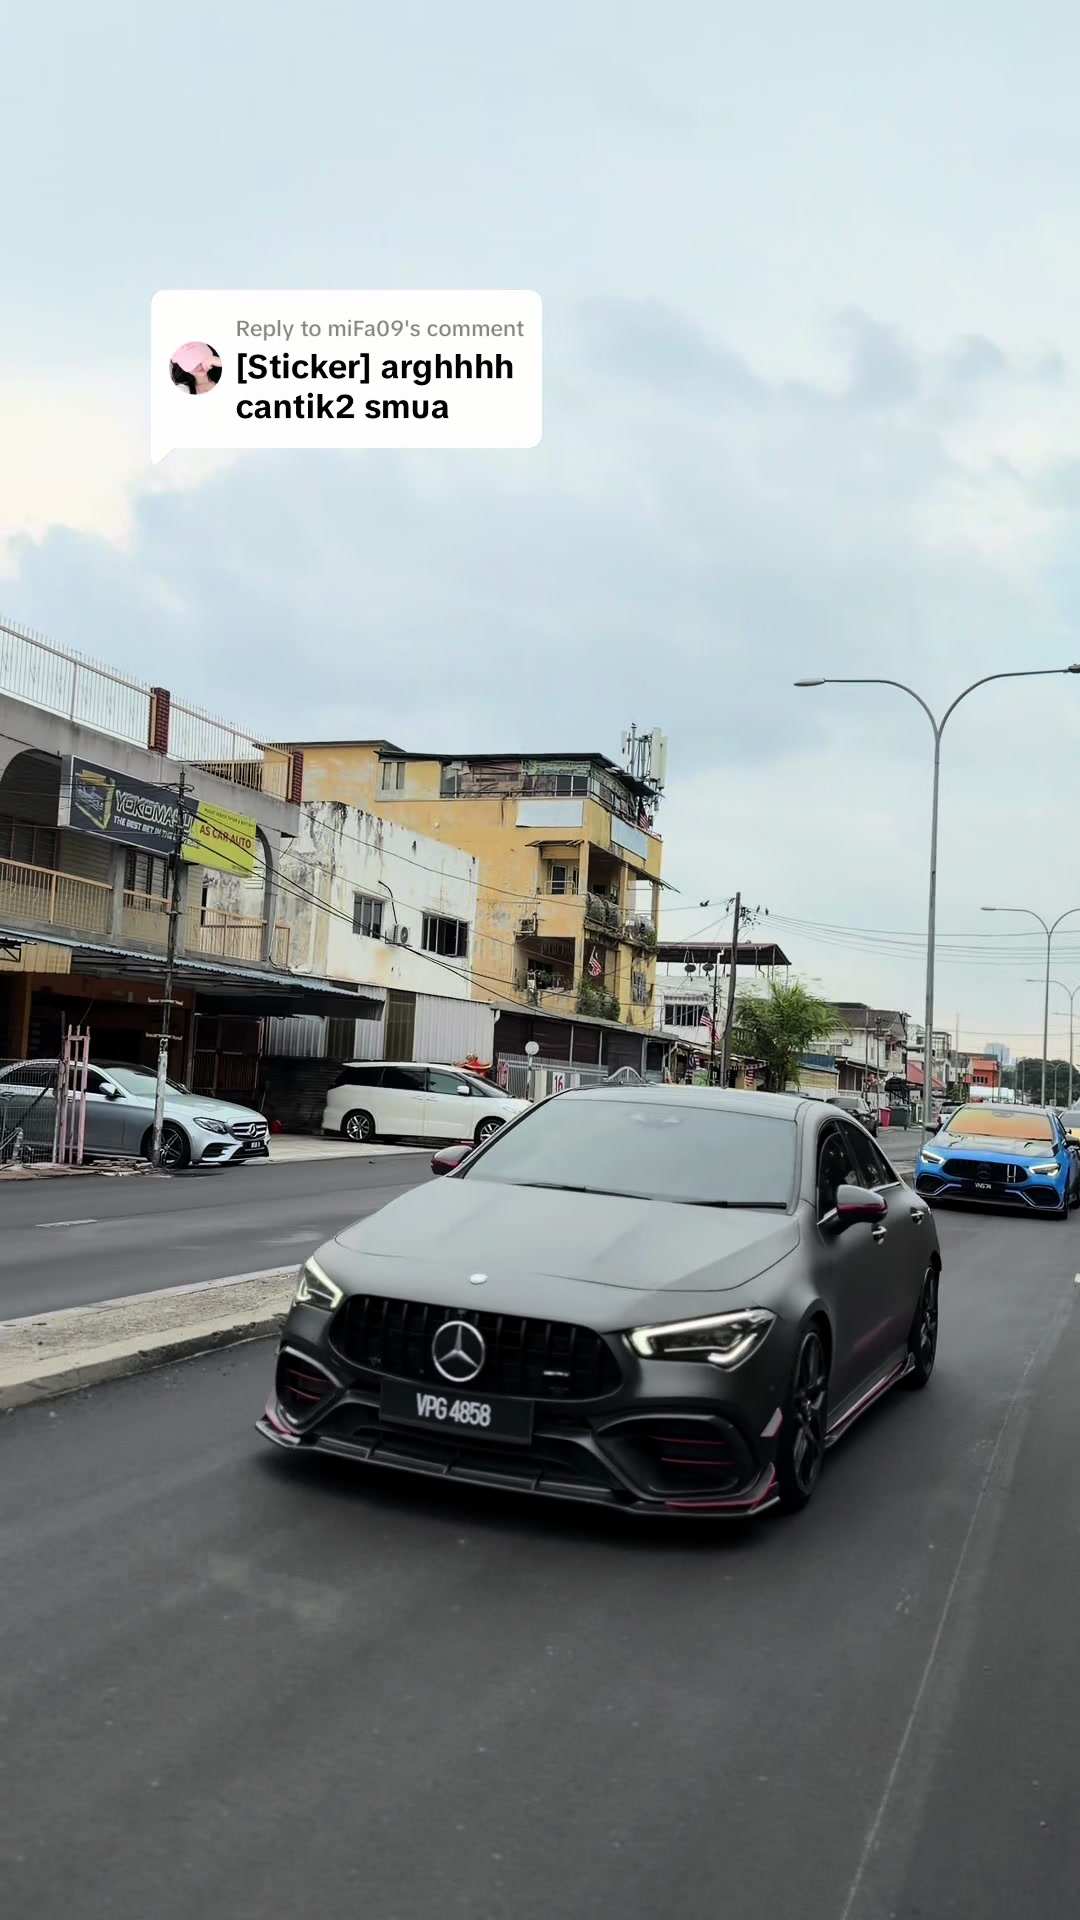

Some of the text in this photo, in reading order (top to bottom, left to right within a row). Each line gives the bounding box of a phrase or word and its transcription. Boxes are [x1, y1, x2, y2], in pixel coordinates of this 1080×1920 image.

[113, 815, 126, 826] THE
[126, 819, 142, 830] BEST
[200, 825, 210, 837] AS
[212, 829, 229, 842] CAR
[230, 834, 252, 848] AUTO
[554, 1075, 564, 1092] 16
[416, 1393, 491, 1427] VPG 4858
